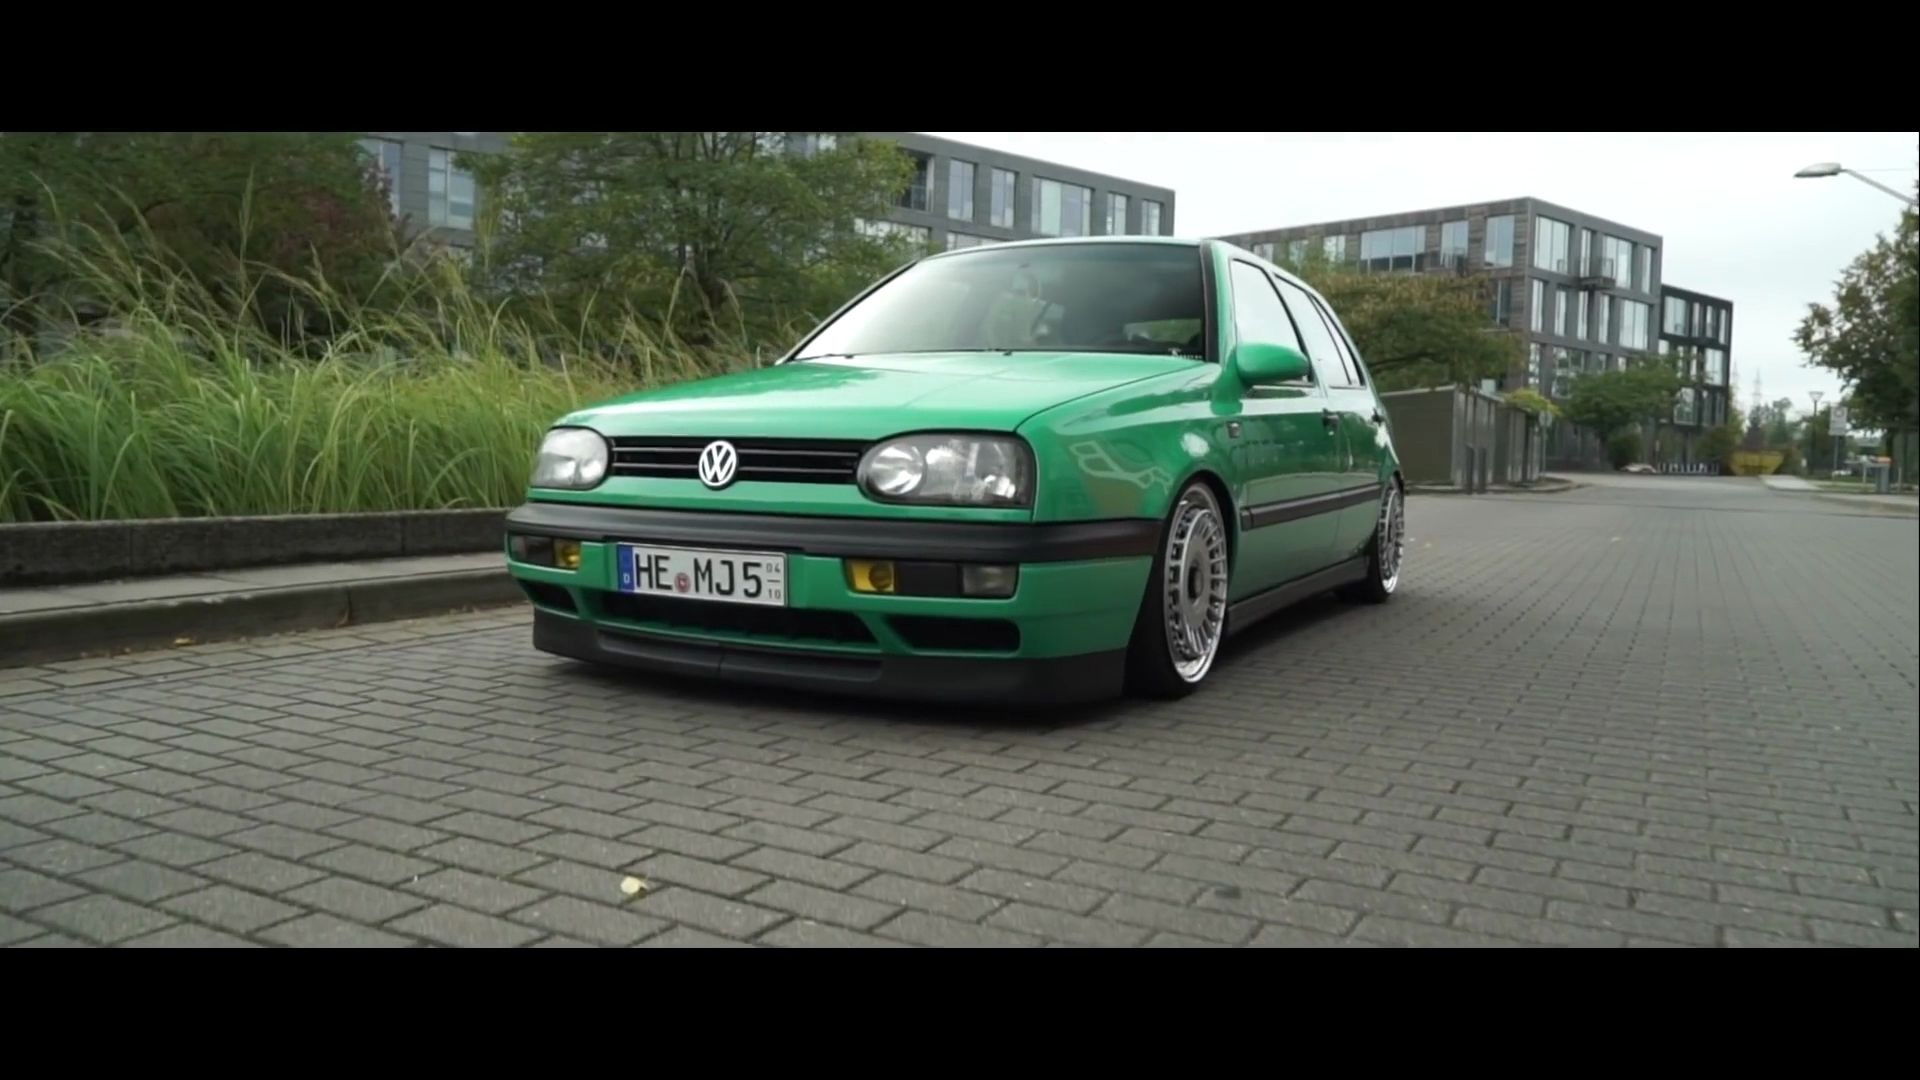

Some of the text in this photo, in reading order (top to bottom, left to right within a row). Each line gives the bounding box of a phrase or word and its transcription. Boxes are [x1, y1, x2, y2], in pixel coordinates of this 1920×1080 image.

[698, 440, 737, 486] VW
[635, 553, 673, 590] HE
[766, 563, 781, 573] 04
[768, 589, 781, 600] 10
